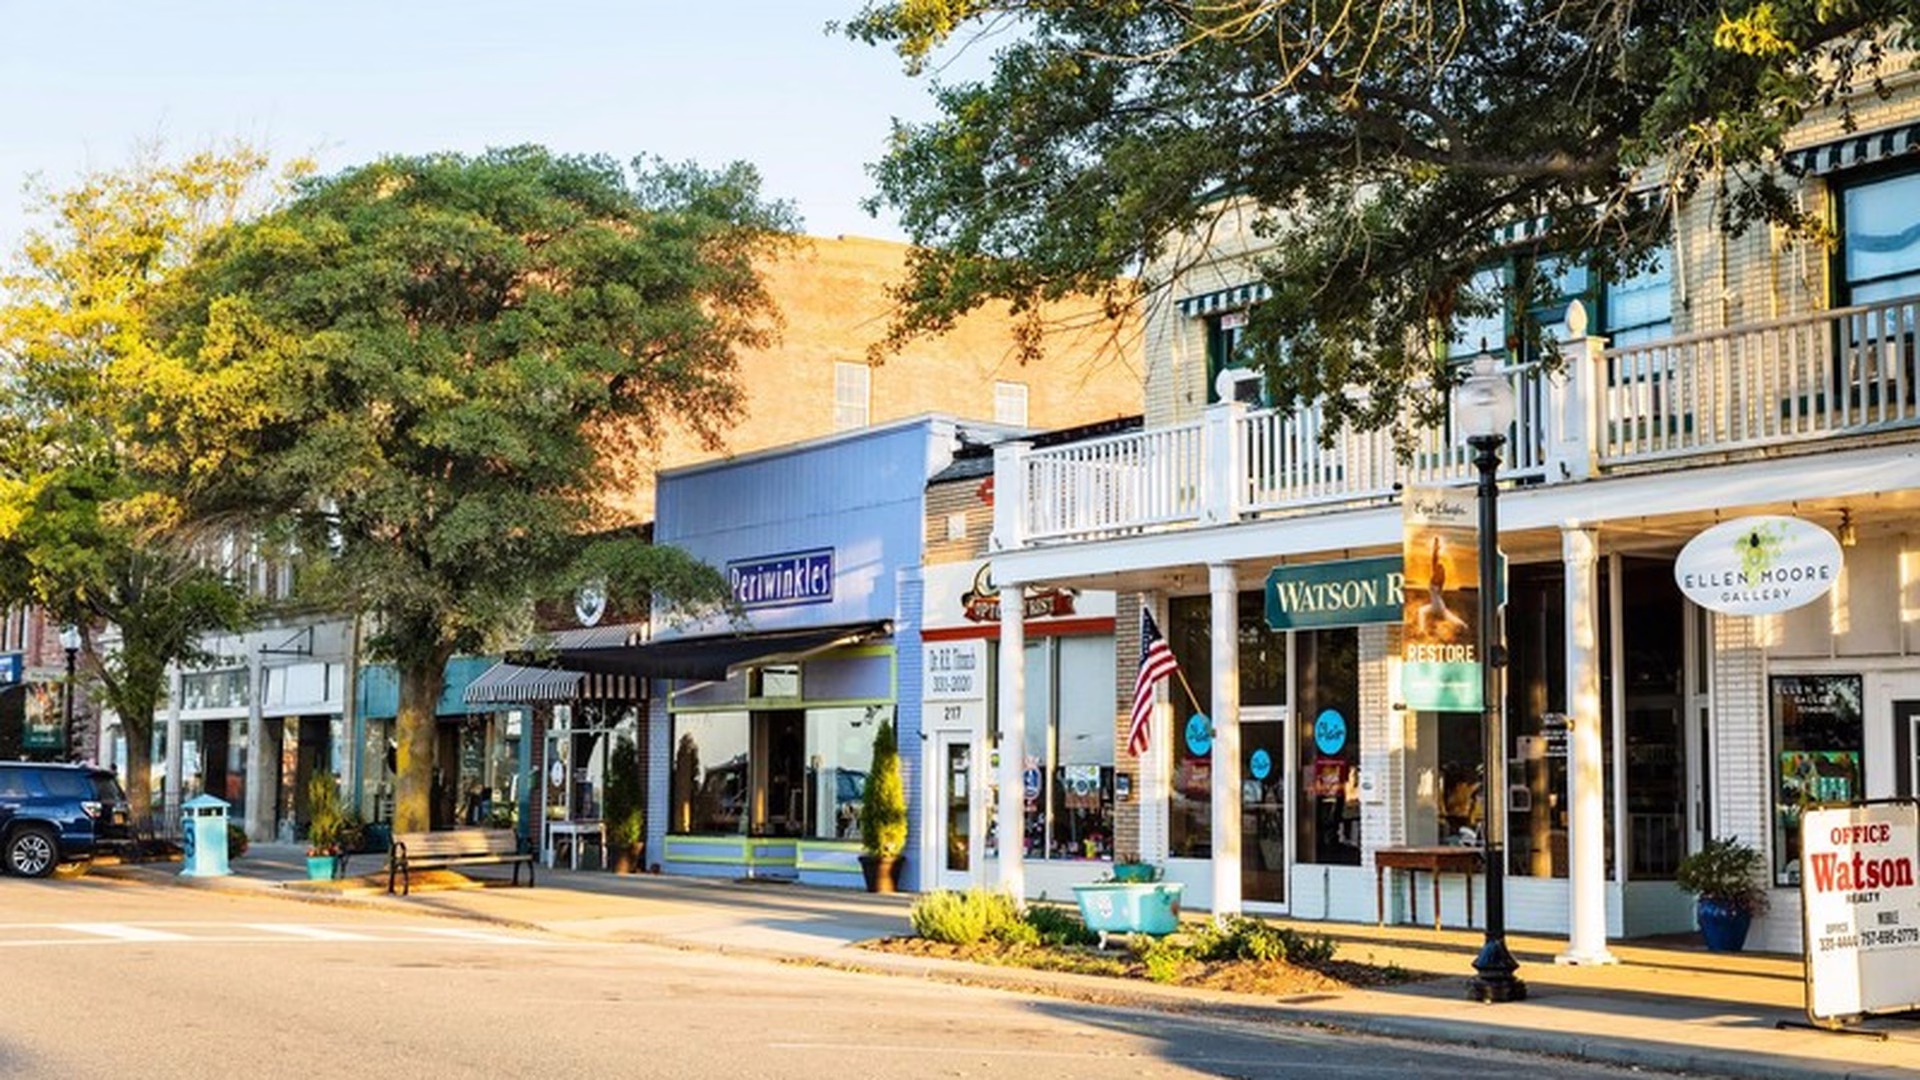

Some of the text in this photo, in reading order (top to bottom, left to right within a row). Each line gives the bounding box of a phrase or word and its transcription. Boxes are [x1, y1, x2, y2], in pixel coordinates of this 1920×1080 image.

[731, 557, 828, 603] Periwinkles
[1684, 565, 1830, 589] ELLEN MOORE
[1721, 588, 1791, 602] GALLERY
[1408, 644, 1475, 664] RESTORE
[944, 705, 961, 720] 217
[1830, 824, 1890, 845] OFFICE
[1810, 851, 1913, 893] Watson
